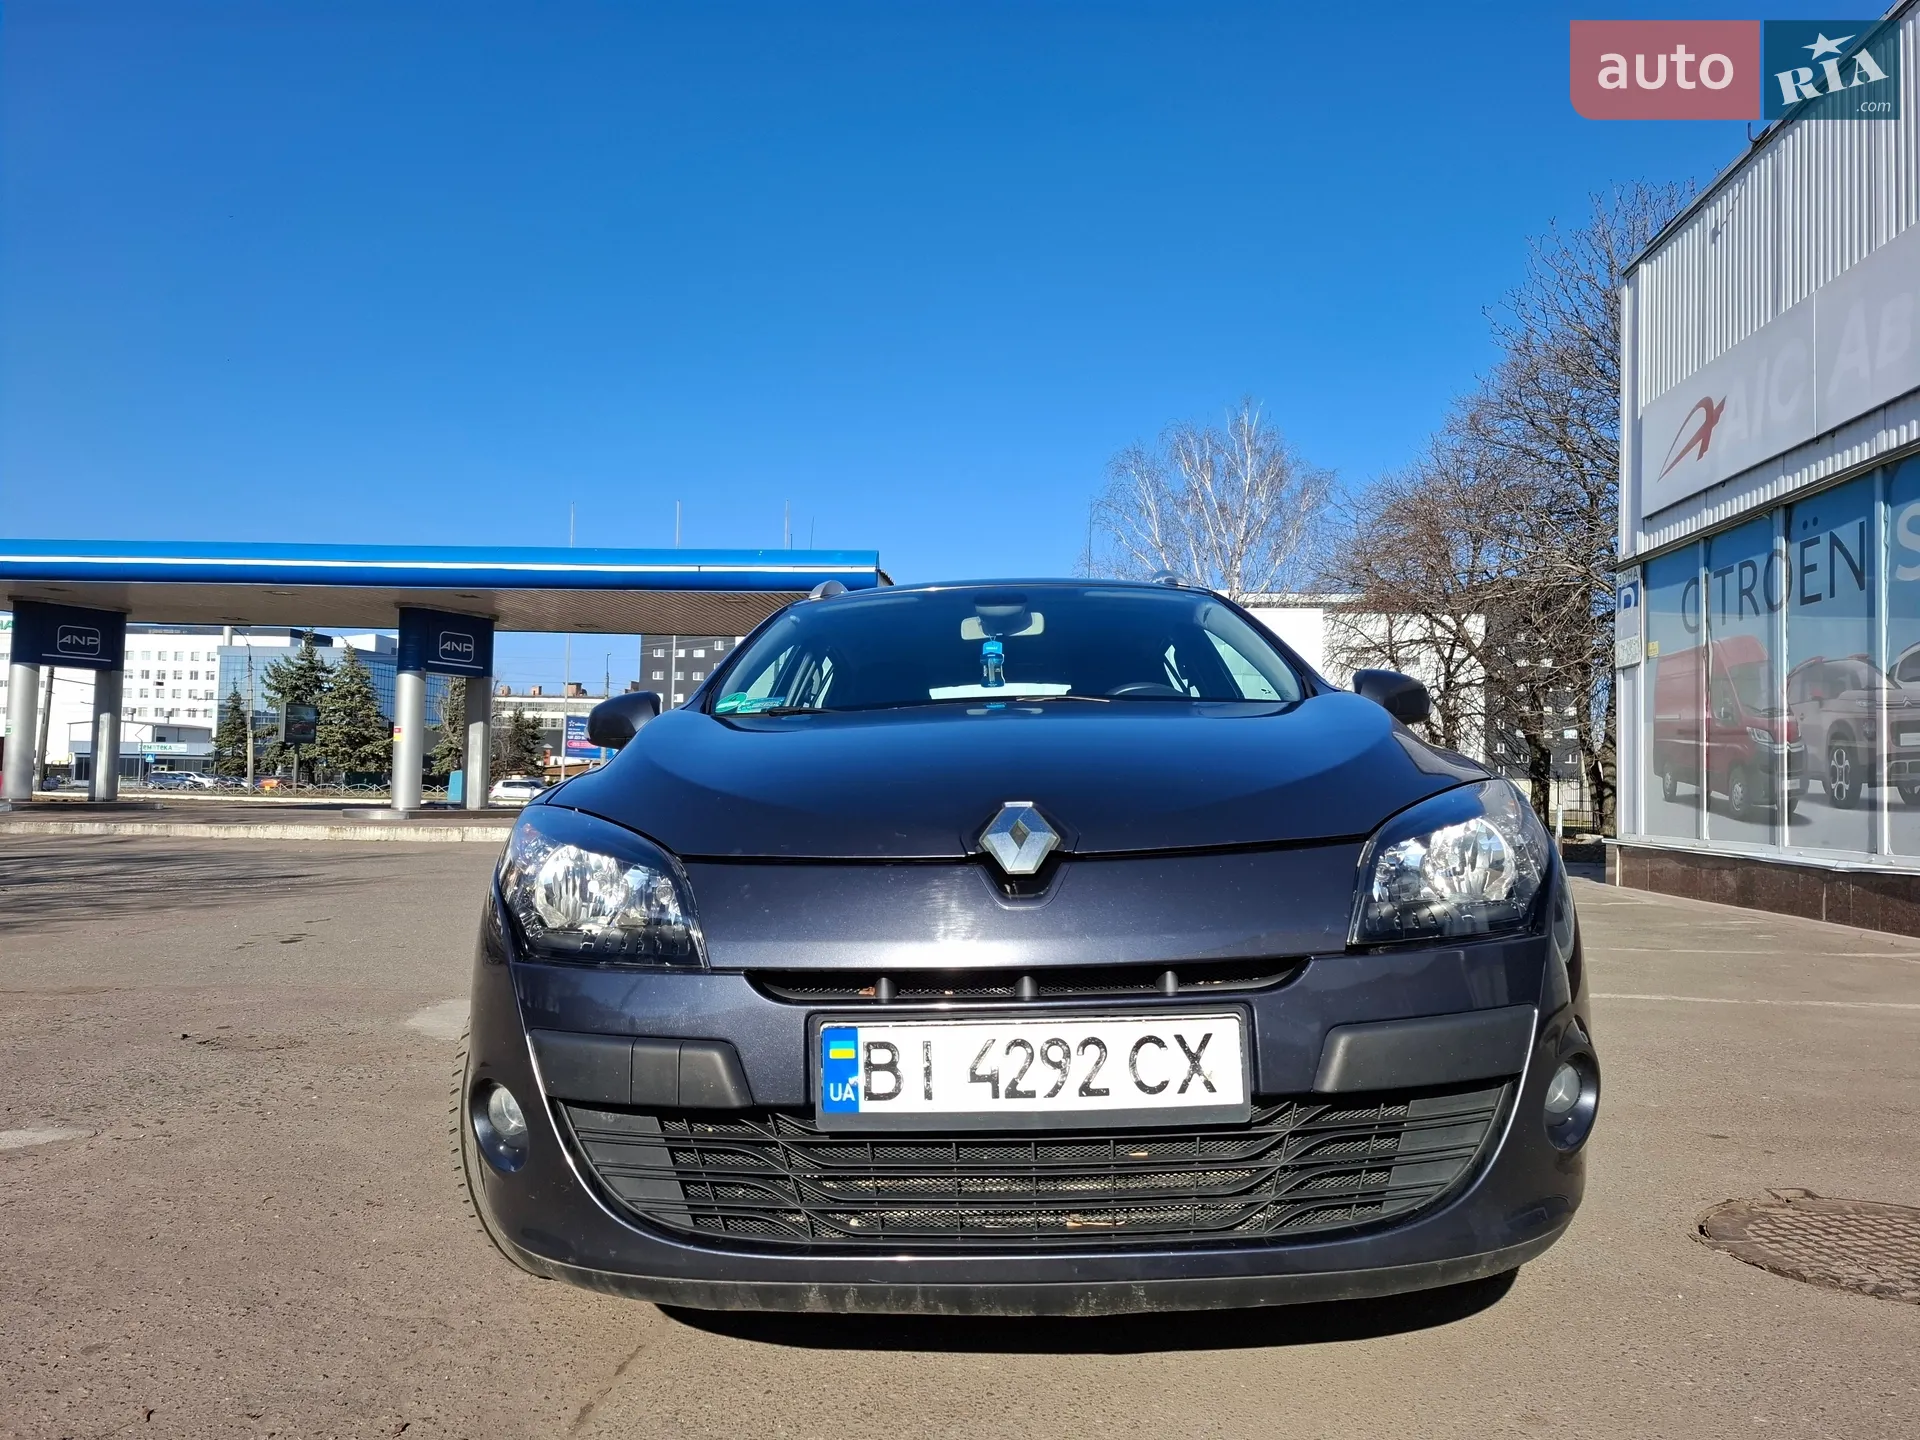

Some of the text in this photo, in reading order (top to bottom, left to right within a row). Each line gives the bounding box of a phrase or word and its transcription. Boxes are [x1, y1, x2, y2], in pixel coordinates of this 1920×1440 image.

[1681, 516, 1867, 634] CTROËN
[59, 634, 100, 646] ANP
[440, 640, 474, 652] ANP
[863, 1032, 1217, 1101] BI 4292 CX
[829, 1082, 856, 1101] UA
